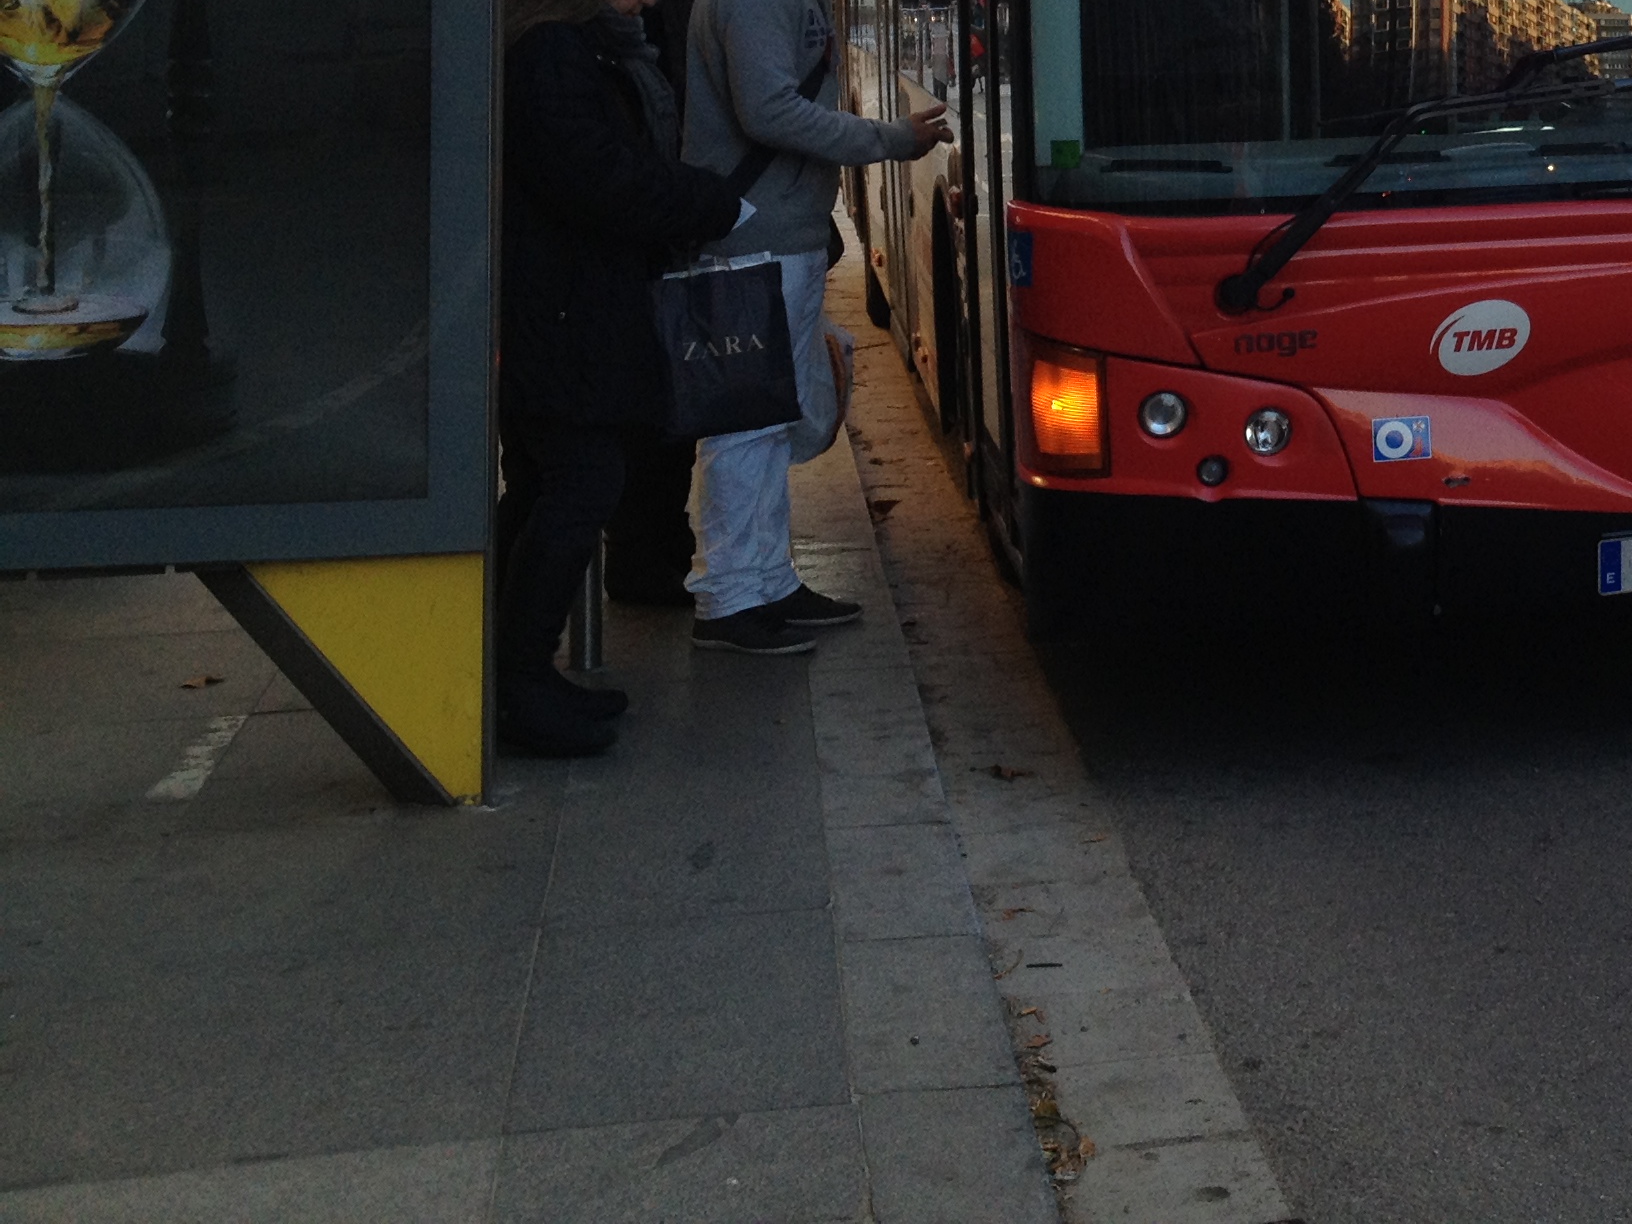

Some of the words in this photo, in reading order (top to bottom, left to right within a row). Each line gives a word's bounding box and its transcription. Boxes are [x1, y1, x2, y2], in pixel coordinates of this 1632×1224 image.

[682, 333, 765, 361] ZARA
[1234, 329, 1318, 357] noge
[1452, 327, 1518, 353] TMB
[1606, 572, 1616, 584] E
